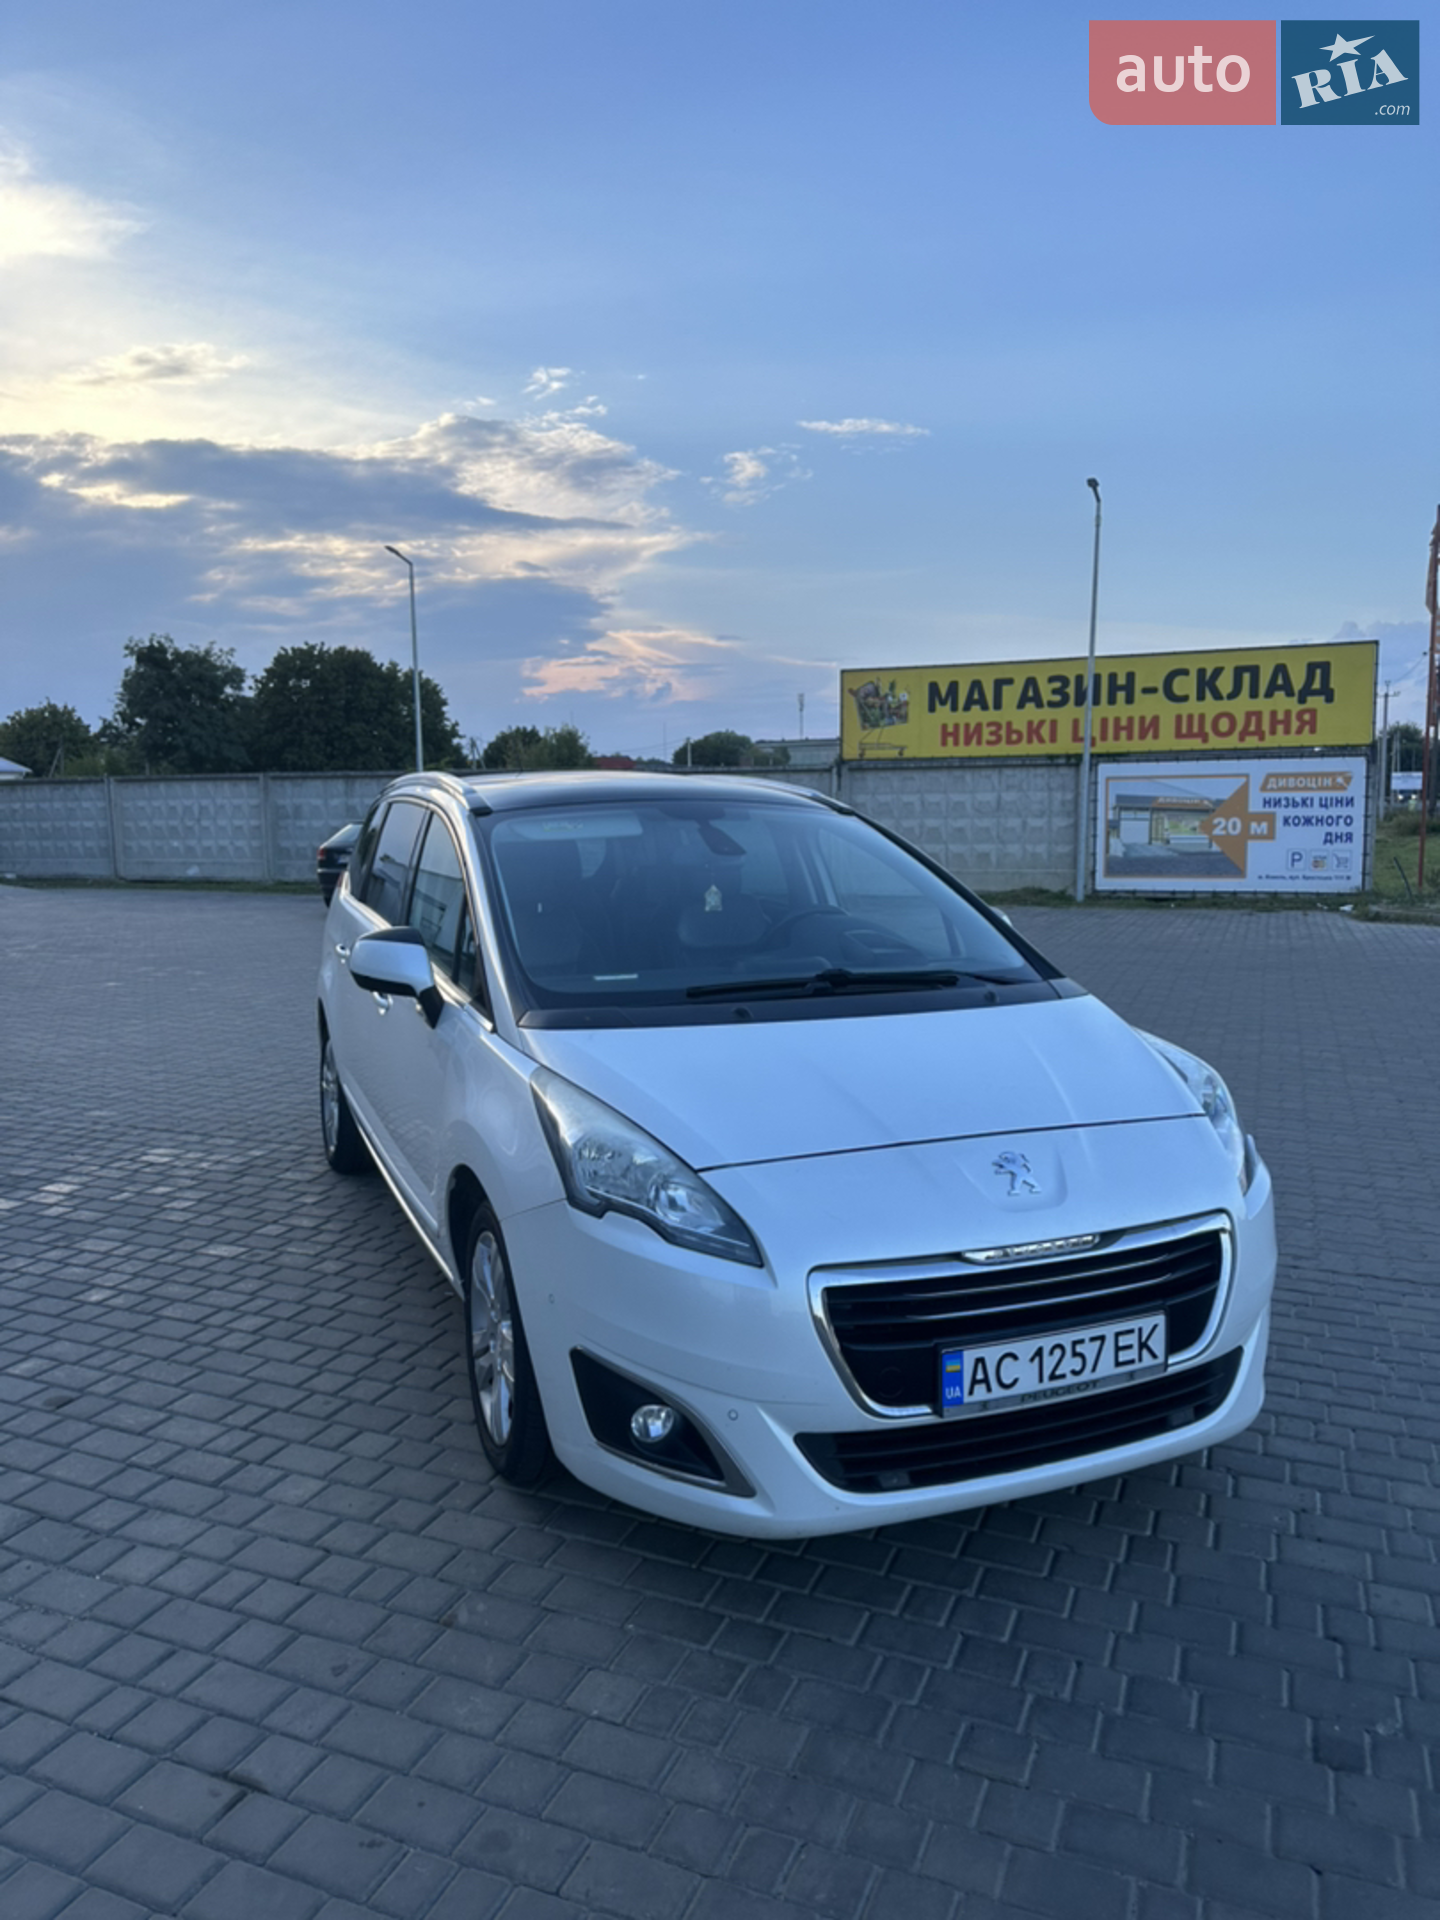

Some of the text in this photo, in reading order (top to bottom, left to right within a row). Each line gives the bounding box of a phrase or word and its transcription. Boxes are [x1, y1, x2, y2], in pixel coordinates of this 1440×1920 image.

[927, 660, 1335, 714] МАГАЗИН-СКЛАД
[939, 718, 1058, 748] НИЗЬКІ
[1173, 707, 1318, 744] ЩОДНЯ
[1266, 776, 1333, 790] ДИВОЦІН
[1262, 796, 1355, 810] НИЗЬКІ ЦІНИ
[1212, 817, 1242, 836] 20
[1282, 815, 1354, 828] КОЖНОГО
[1322, 831, 1354, 846] ДНЯ
[967, 1351, 1020, 1397] AC
[1029, 1334, 1107, 1384] 1257
[945, 1385, 962, 1399] UA
